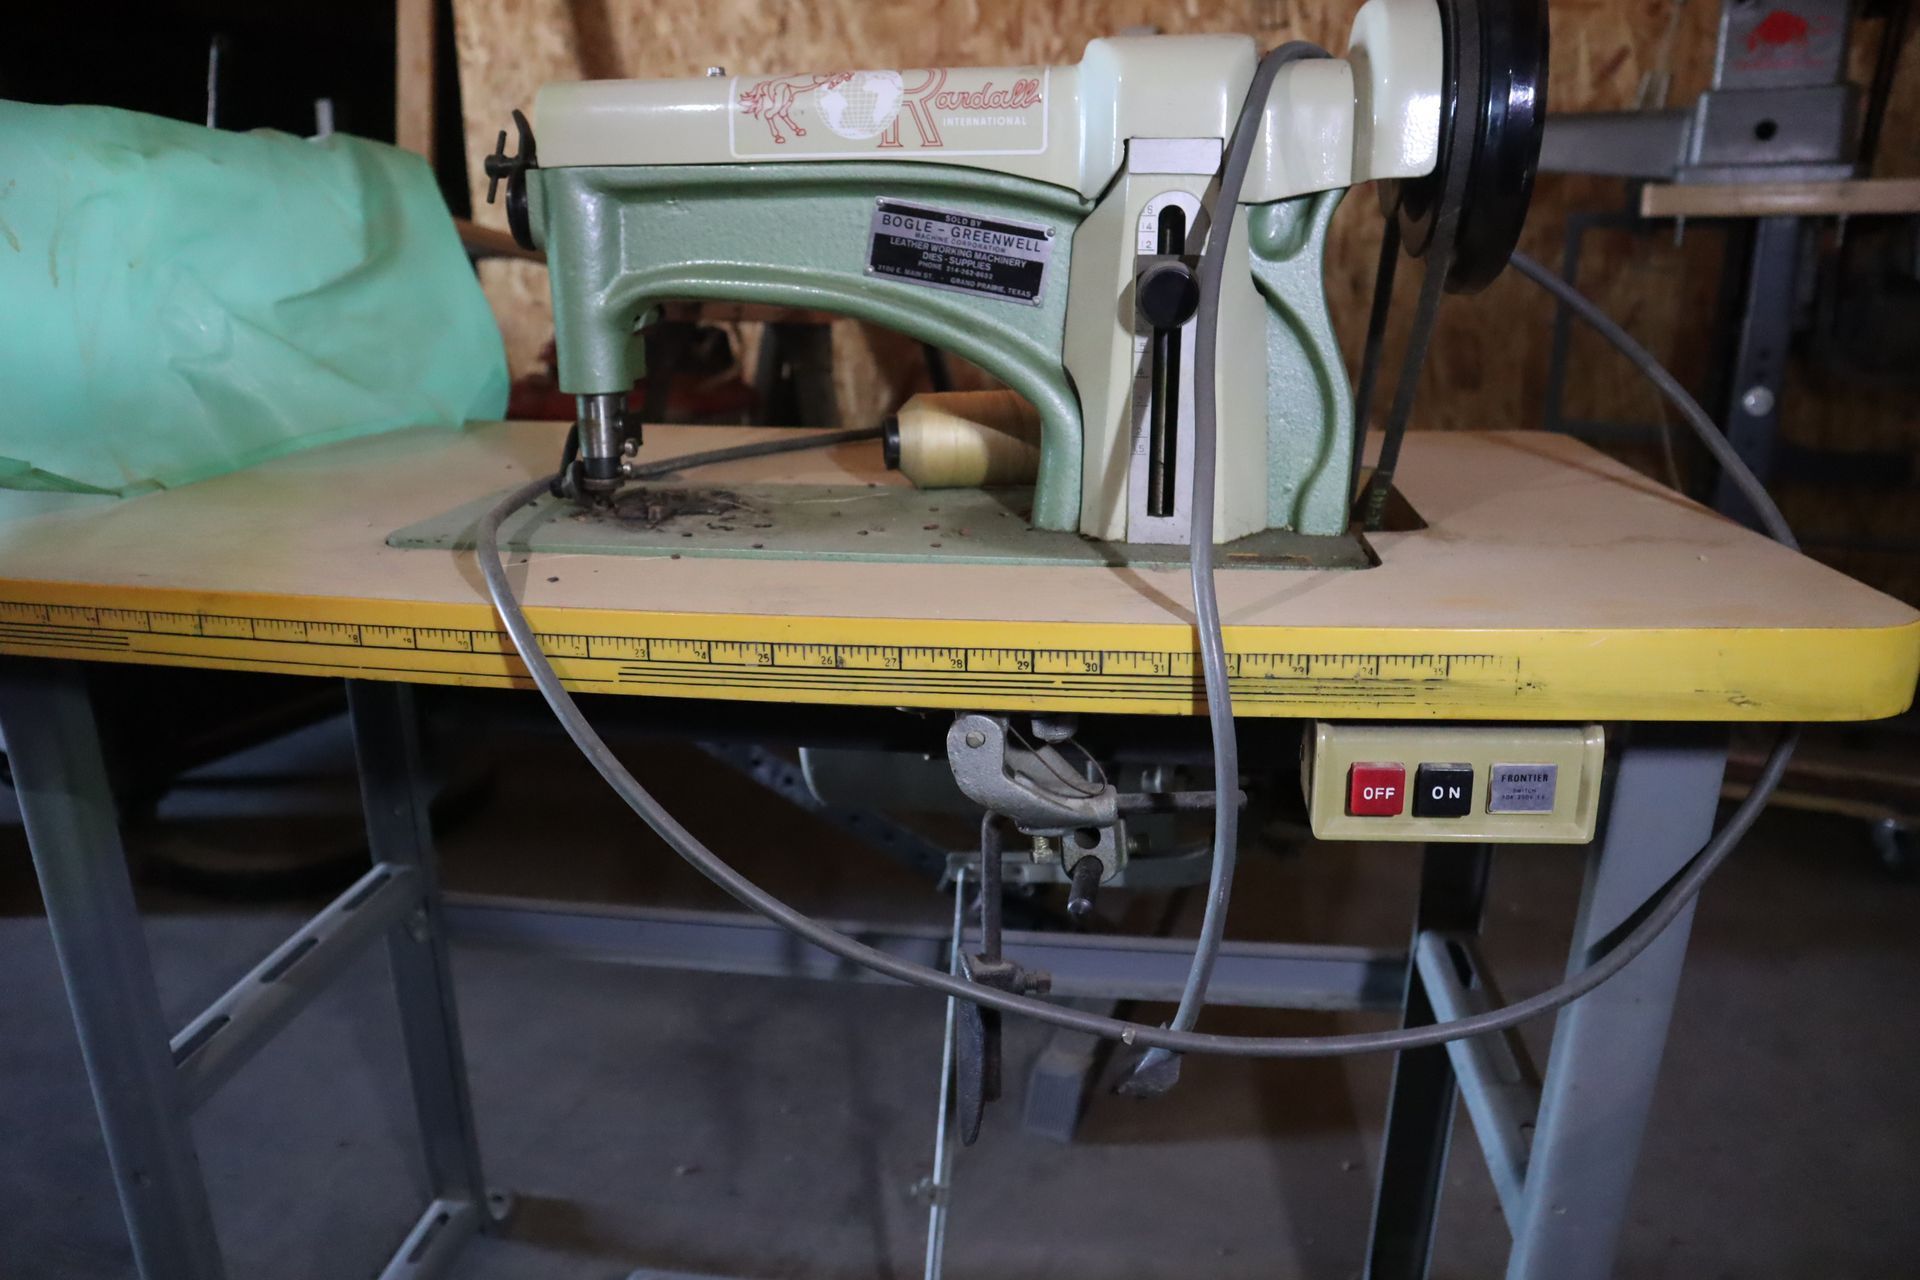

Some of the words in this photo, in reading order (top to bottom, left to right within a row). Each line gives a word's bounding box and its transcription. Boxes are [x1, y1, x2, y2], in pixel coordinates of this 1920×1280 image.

[877, 67, 1042, 147] Randall
[943, 115, 1028, 127] INTERNATIONAL
[945, 214, 968, 225] SOLD
[969, 219, 983, 228] BY
[882, 213, 933, 233] BOGLE
[950, 226, 1041, 253] GREENWELL
[914, 232, 949, 244] MACHINE
[951, 239, 1007, 254] CORPORATION
[889, 236, 930, 251] LEATHER
[930, 243, 973, 259] WORKING
[973, 251, 1028, 269] MACHINERY
[922, 251, 943, 263] DIES
[948, 256, 992, 272] SUPPLIES
[1007, 286, 1032, 298] TEXAS
[757, 652, 770, 663] 25
[820, 652, 833, 665] 26
[884, 658, 897, 668] 27
[950, 658, 963, 669] 28
[1017, 661, 1030, 671] 29
[1085, 662, 1098, 673] 30
[1153, 664, 1165, 674] 31
[1500, 773, 1549, 783] FRONTIER
[1363, 786, 1396, 801] OFF
